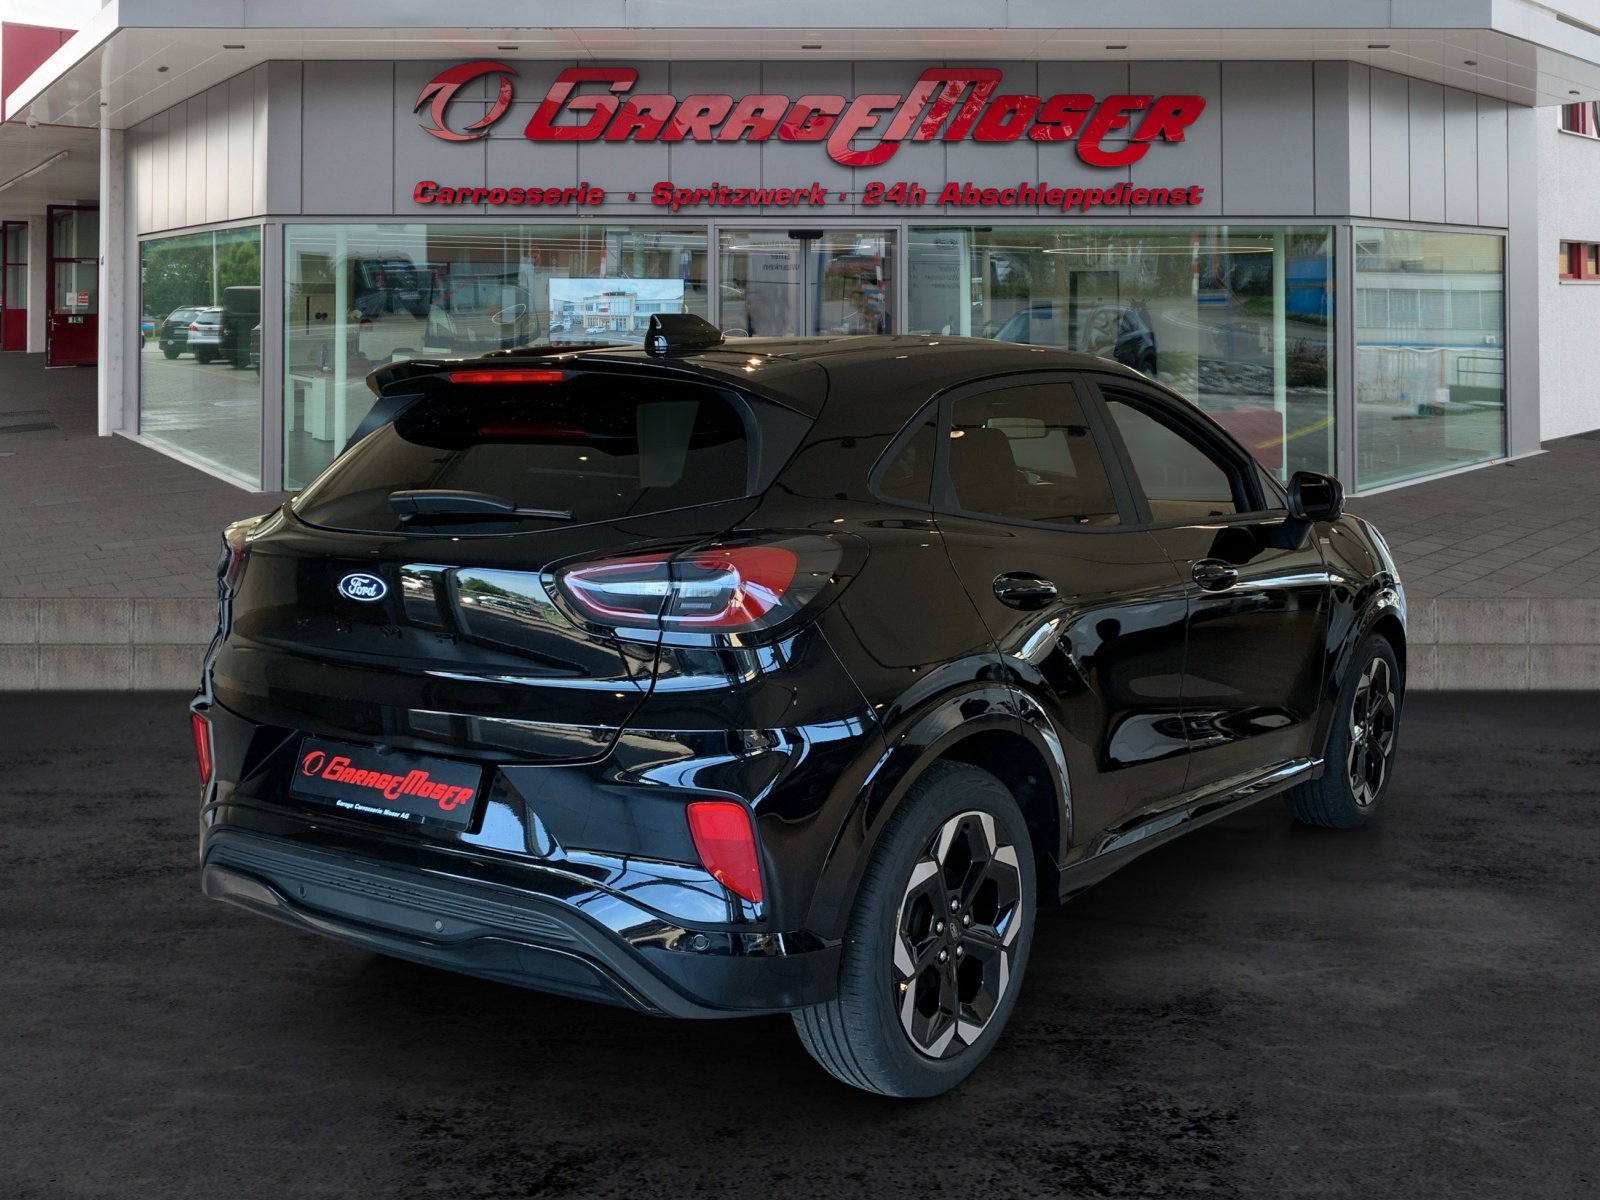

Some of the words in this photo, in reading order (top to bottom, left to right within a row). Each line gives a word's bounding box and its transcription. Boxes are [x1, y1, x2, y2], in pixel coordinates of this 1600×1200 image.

[413, 181, 604, 205] Carrosserie
[651, 181, 826, 211] Spritzwerk
[862, 182, 926, 206] 24h
[936, 182, 1204, 211] Abschleppdienst
[348, 577, 377, 597] Ford
[336, 799, 354, 809] Garage
[354, 803, 383, 815] Carrosserie
[383, 808, 401, 818] Moser
[400, 812, 410, 820] AG
